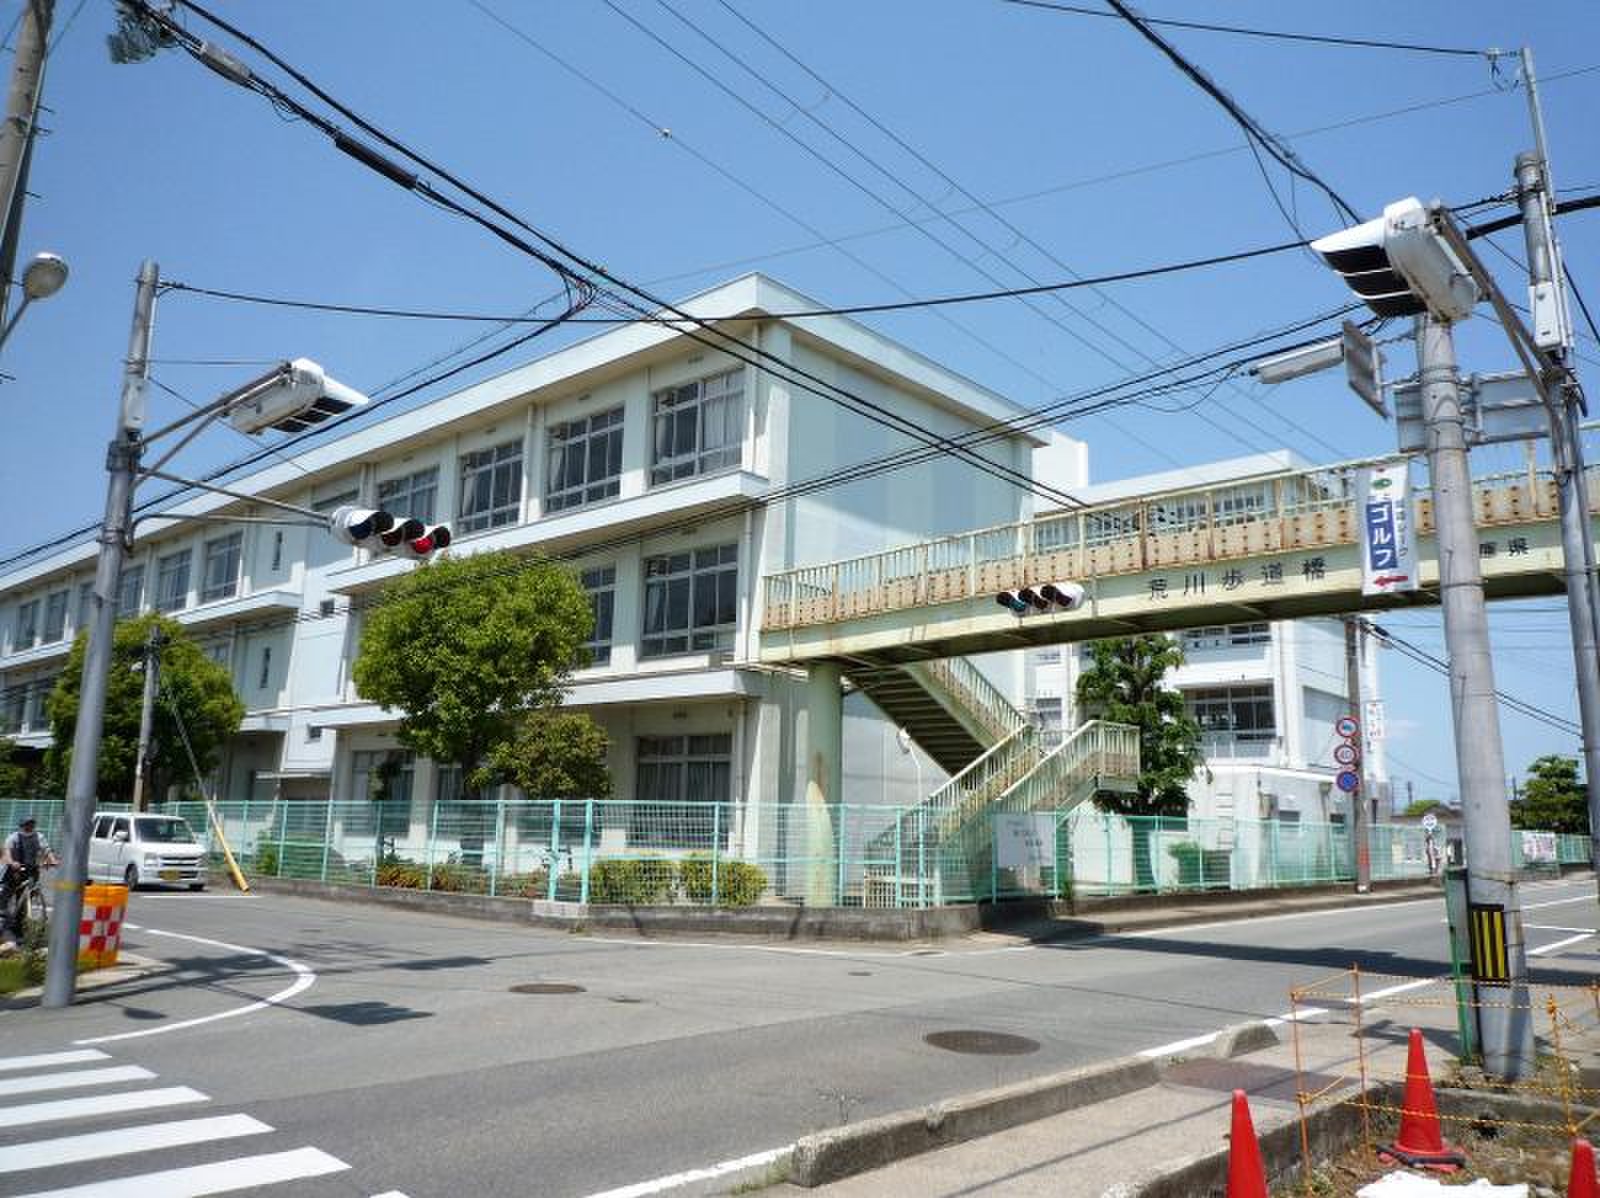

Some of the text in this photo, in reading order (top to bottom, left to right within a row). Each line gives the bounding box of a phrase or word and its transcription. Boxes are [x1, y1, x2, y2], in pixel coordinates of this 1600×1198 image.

[1370, 504, 1392, 567] ゴルフ
[1149, 556, 1329, 601] 荒川歩道橋
